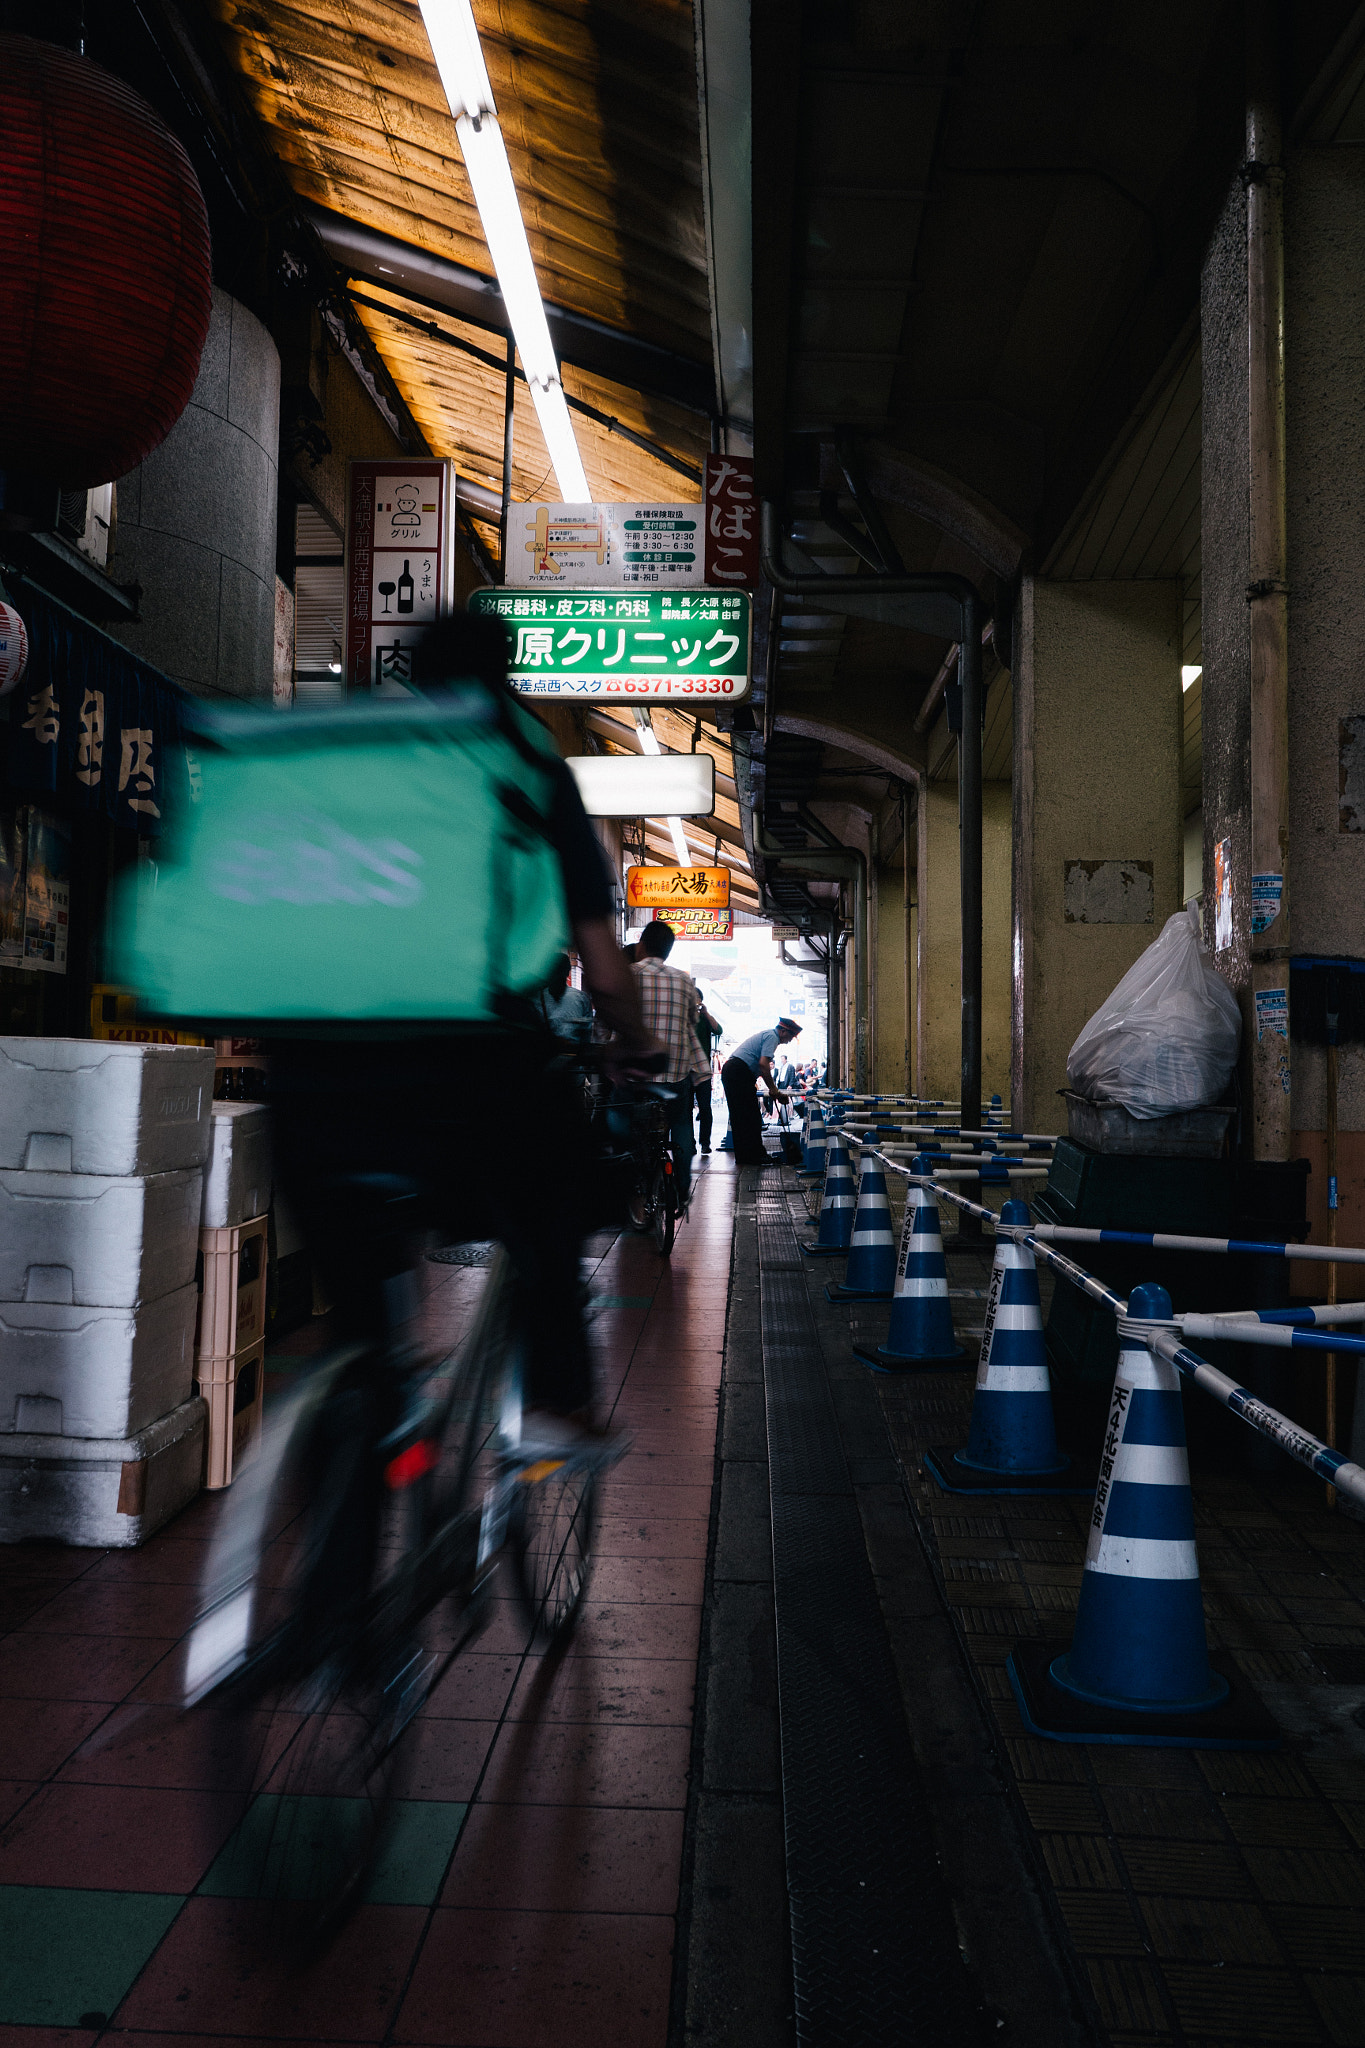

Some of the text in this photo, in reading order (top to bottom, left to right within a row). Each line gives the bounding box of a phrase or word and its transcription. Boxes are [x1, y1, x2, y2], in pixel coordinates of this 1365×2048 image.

[635, 510, 684, 519] 各種保険取扱
[709, 461, 756, 581] たばこ
[642, 522, 675, 530] 受付時間
[391, 529, 421, 539] グリル
[624, 533, 640, 541] 午前
[353, 476, 372, 621] 天満駅前西洋酒場
[624, 542, 640, 550] 午後
[643, 553, 673, 561] 休診日
[420, 559, 433, 602] うまい
[505, 627, 740, 667] 原クリニック
[376, 639, 415, 685] 肉
[624, 679, 735, 693] 6371-3330
[670, 871, 710, 895] 穴場
[657, 909, 714, 921] ネットカフェ
[685, 921, 729, 935] ポパイ
[791, 1003, 804, 1012] JR
[108, 1029, 178, 1045] KIRIN
[897, 1206, 916, 1277] 天4北商店会
[981, 1267, 1003, 1362] 天4北商店会
[1093, 1386, 1130, 1528] 天4北商店会
